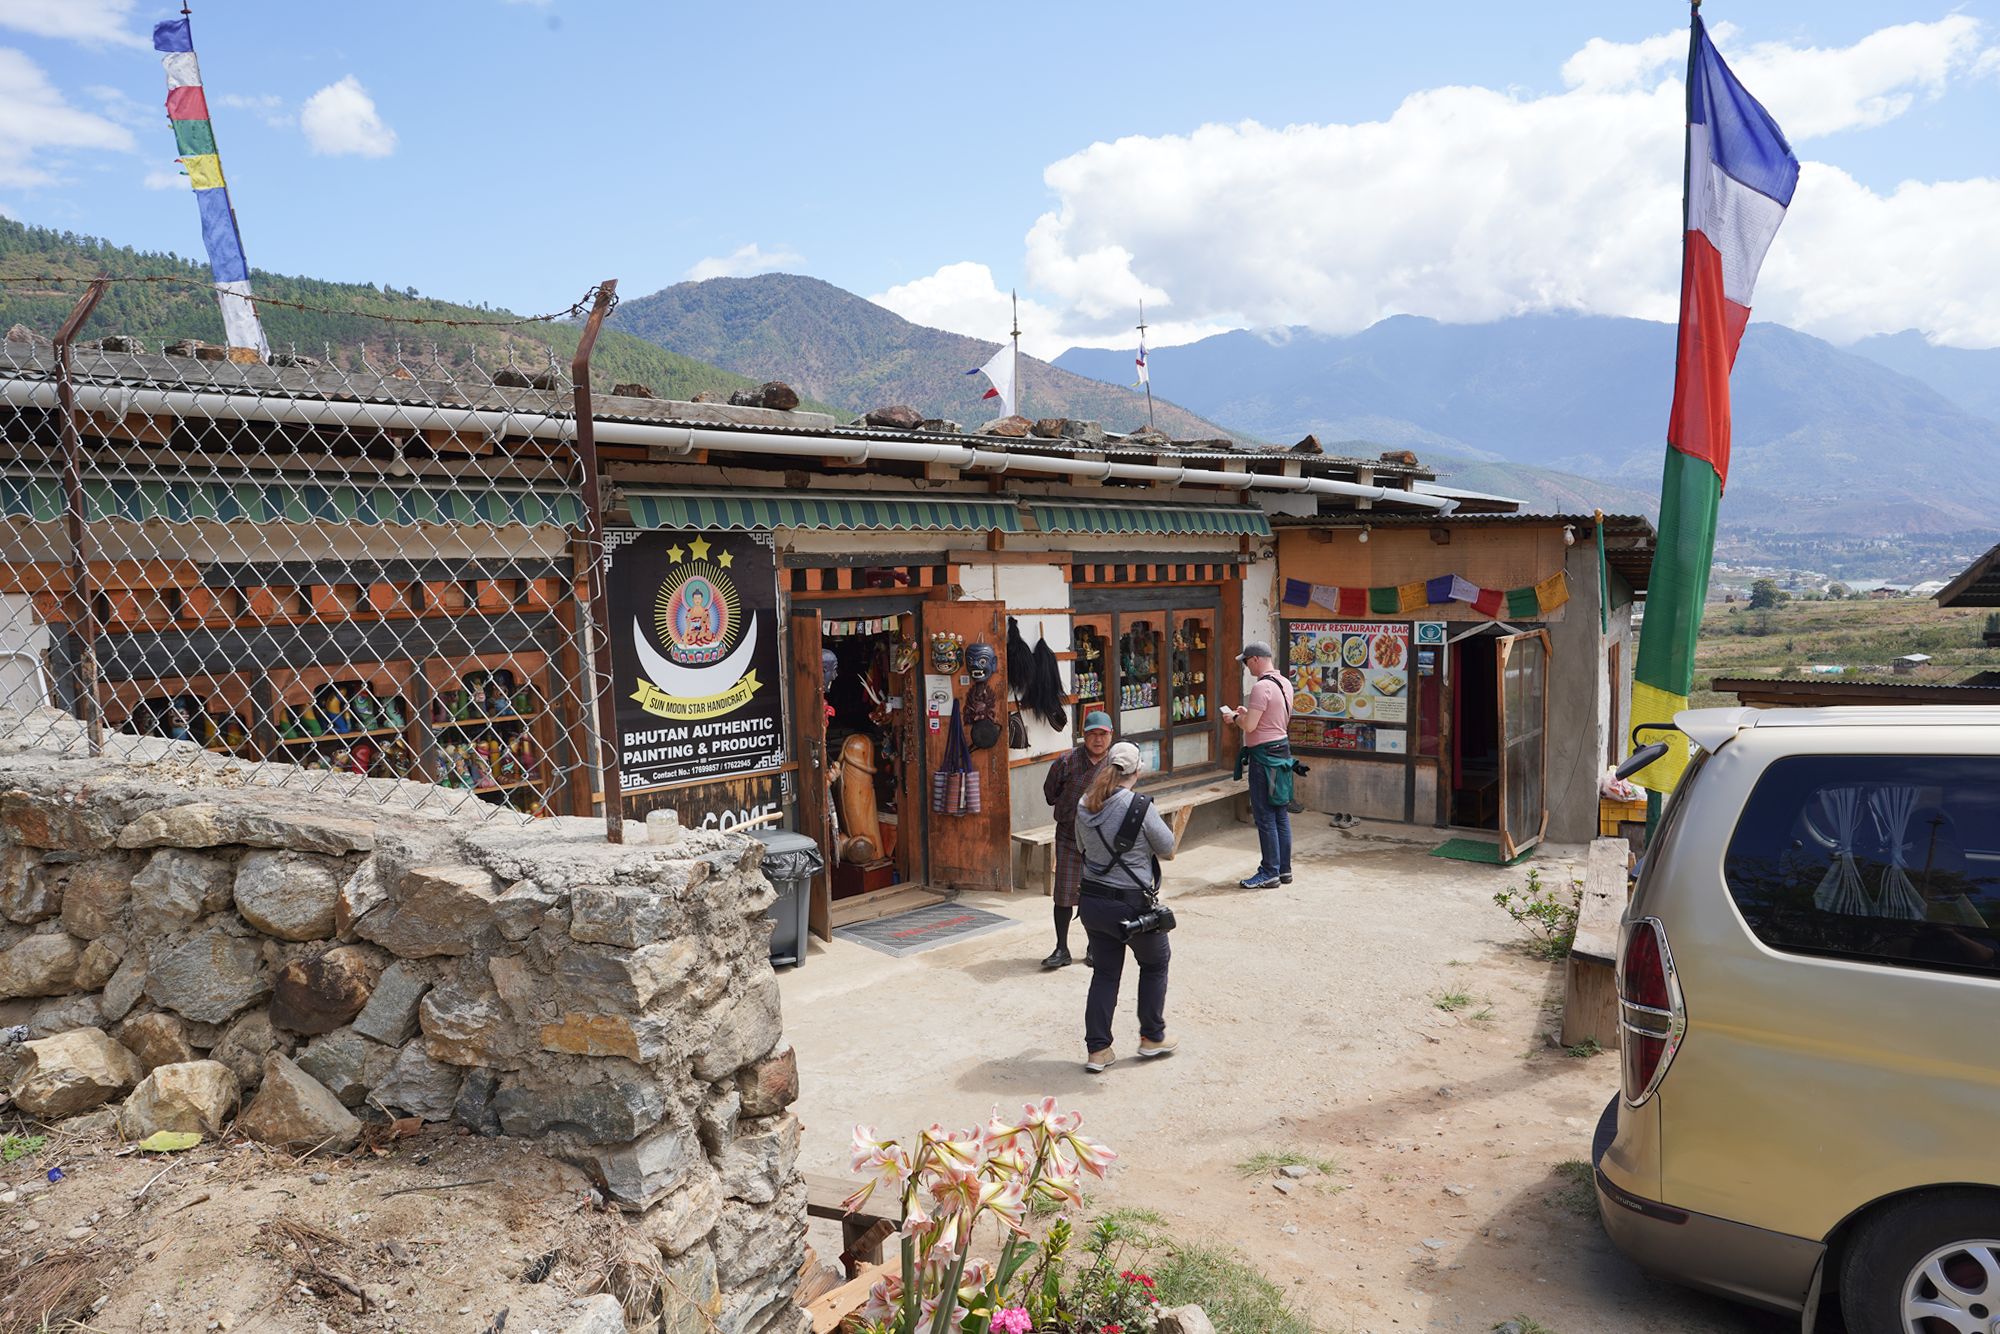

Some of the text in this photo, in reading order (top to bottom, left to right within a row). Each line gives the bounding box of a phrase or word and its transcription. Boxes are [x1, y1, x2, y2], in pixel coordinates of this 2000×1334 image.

[1290, 623, 1409, 634] CREATIVE RESTAURANT & BAR
[649, 688, 748, 715] SUN MOON STAR HANDICRAFT
[624, 717, 774, 746] BHUTAN AUTHENTIC
[623, 734, 775, 765] PAINTING & PRODUCT
[652, 769, 678, 780] Contact
[678, 767, 691, 776] No.:
[702, 802, 777, 832] COME
